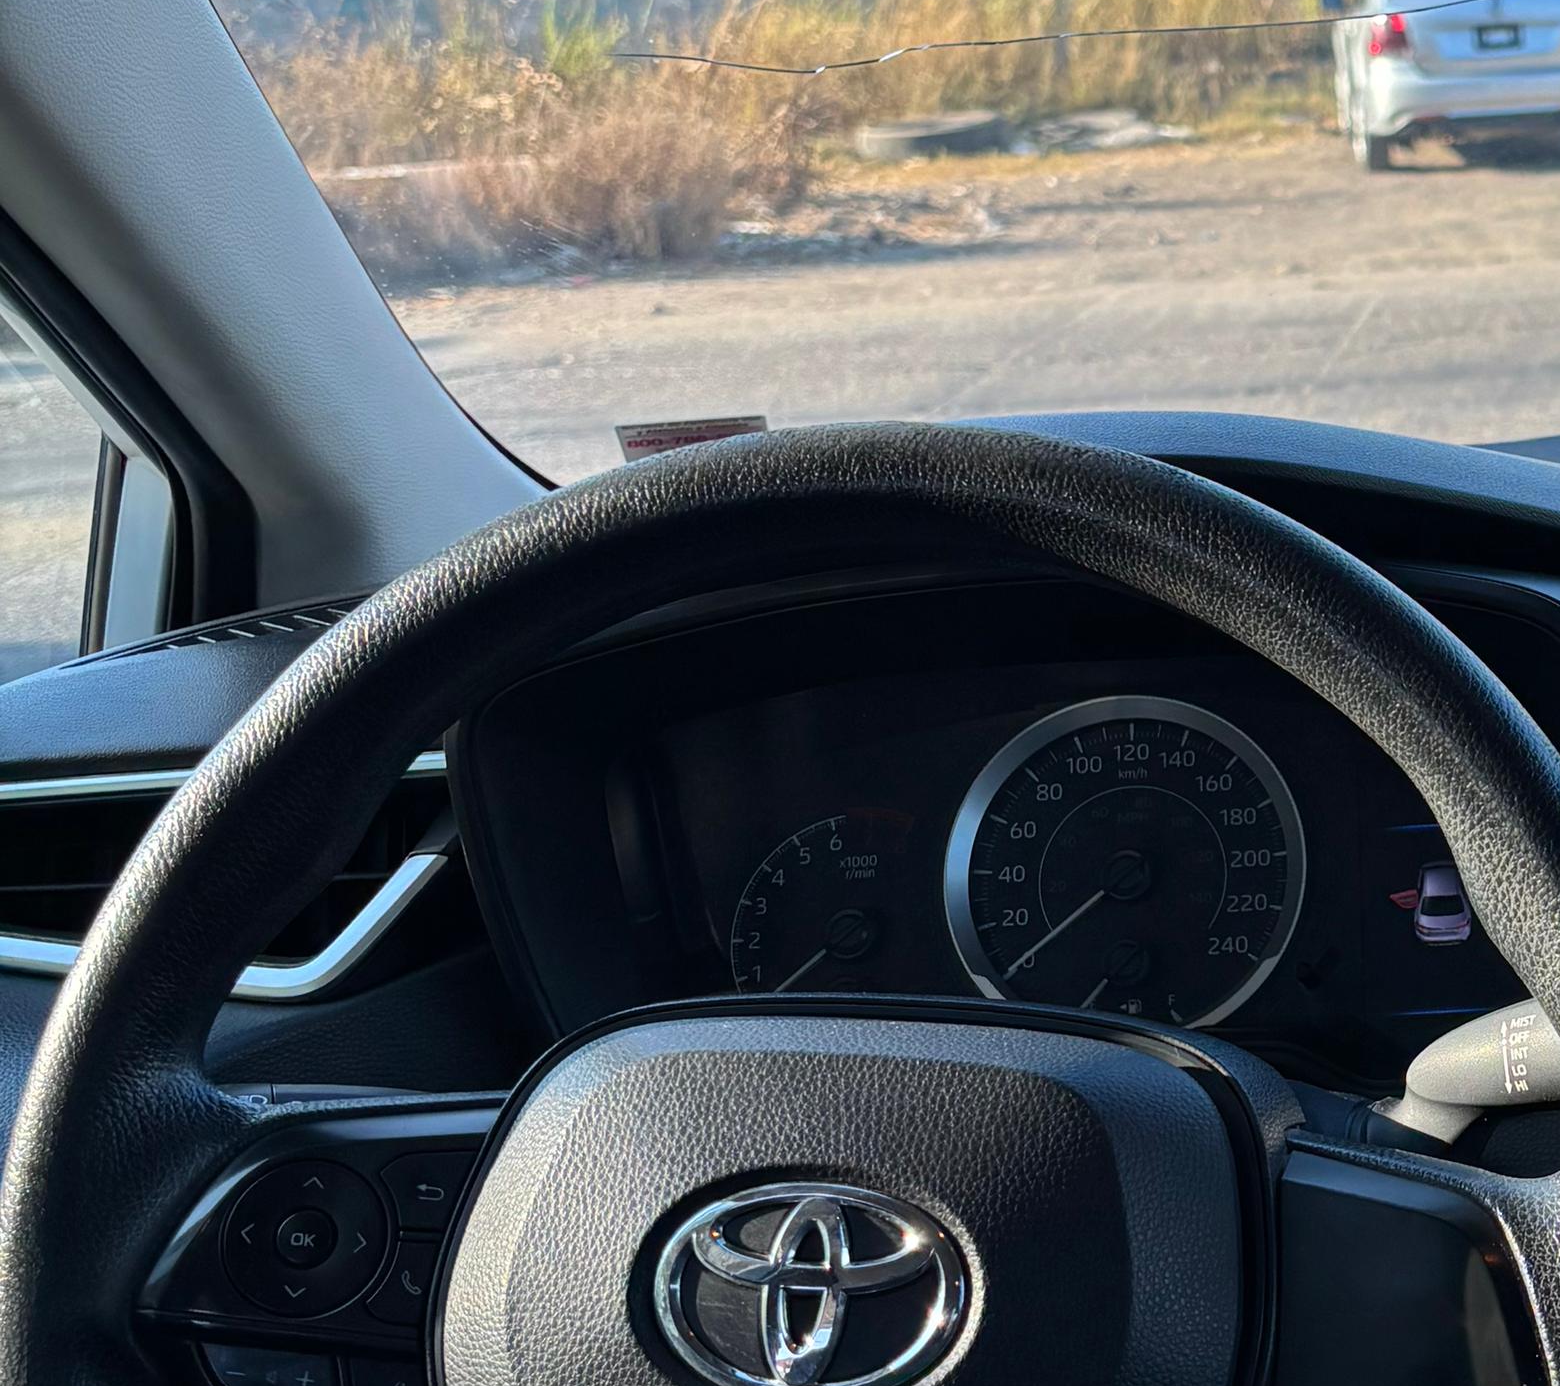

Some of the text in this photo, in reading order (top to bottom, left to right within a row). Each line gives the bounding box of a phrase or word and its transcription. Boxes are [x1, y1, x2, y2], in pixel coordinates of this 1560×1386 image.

[1113, 743, 1150, 762] 120
[1159, 749, 1196, 769] 140
[1065, 754, 1103, 775] 100
[1118, 767, 1149, 781] km/h
[1035, 782, 1064, 802] 80
[1195, 773, 1233, 793] 160
[1219, 806, 1257, 827] 180
[1009, 820, 1037, 840] 60
[829, 832, 843, 852] 6
[798, 846, 812, 865] 5
[839, 853, 879, 869] x1000
[1229, 849, 1272, 869] 200
[771, 868, 785, 887] 4
[845, 868, 876, 881] r/min
[997, 864, 1026, 884] 40
[754, 897, 768, 915] 3
[1226, 893, 1268, 914] 220
[1001, 907, 1030, 928] 20
[748, 931, 761, 950] 2
[1207, 934, 1249, 956] 240
[751, 964, 762, 983] 1
[1167, 993, 1176, 1007] F
[1509, 1014, 1537, 1029] MIST
[1509, 1030, 1530, 1044] OFF
[1510, 1045, 1529, 1061] INT
[1511, 1063, 1528, 1077] LO
[1513, 1079, 1529, 1092] HI
[290, 1232, 317, 1249] OK
